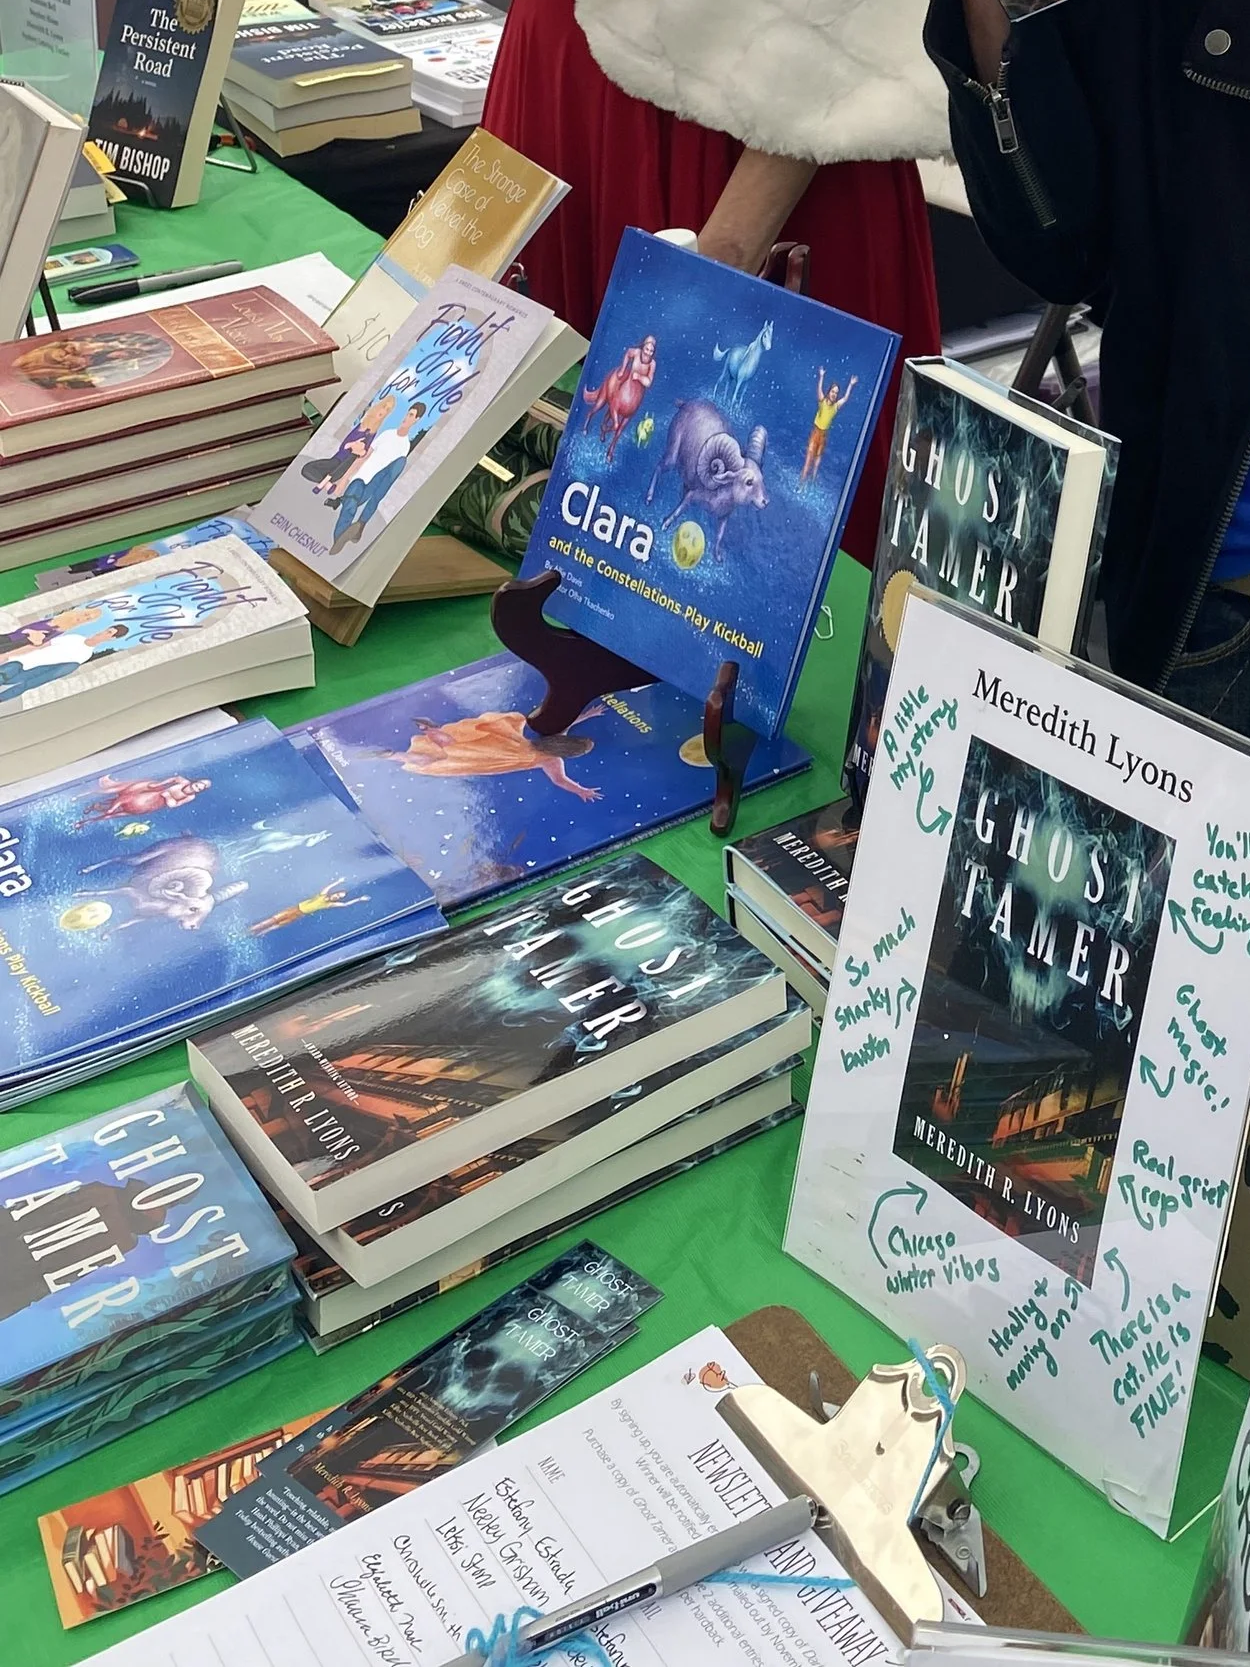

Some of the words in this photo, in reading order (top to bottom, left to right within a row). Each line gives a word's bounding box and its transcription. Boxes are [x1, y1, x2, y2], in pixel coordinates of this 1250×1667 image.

[120, 24, 196, 60] Persistent
[150, 8, 178, 31] The
[235, 26, 282, 39] BISH
[283, 22, 320, 32] TIM
[134, 51, 173, 78] Road
[95, 139, 119, 165] TIM
[120, 146, 170, 181] BISHOP
[446, 168, 476, 203] Case
[475, 196, 493, 211] of
[463, 143, 485, 174] The
[484, 159, 526, 204] Strange
[408, 212, 434, 249] Dog
[430, 189, 465, 228] Velvet
[461, 217, 483, 245] the
[416, 303, 515, 374] Fight
[379, 369, 418, 400] for
[408, 359, 480, 417] Me
[903, 422, 1027, 540] GHOST
[270, 513, 291, 533] ERIN
[288, 524, 328, 557] CHESNUT
[561, 482, 654, 563] Clara
[891, 494, 1018, 624] TAMER
[86, 595, 138, 613] for
[114, 604, 203, 644] Me
[138, 561, 268, 618] Fight
[549, 535, 572, 555] and
[574, 547, 595, 568] the
[597, 560, 681, 615] Constellations
[684, 605, 710, 632] Play
[712, 620, 764, 659] Kickball
[601, 693, 653, 736] tellations
[883, 730, 900, 755] A
[895, 686, 930, 731] little
[890, 698, 958, 790] mystery
[971, 668, 1098, 757] Meredith
[1105, 733, 1194, 804] Lyons
[773, 832, 848, 891] MEREDITH
[975, 790, 1151, 926] GHOST
[561, 880, 716, 1000] GHOST
[845, 956, 871, 987] So
[873, 907, 917, 958] much
[960, 857, 1131, 1008] TAMER
[5, 953, 28, 976] Play
[20, 974, 61, 1017] Kickball
[483, 907, 648, 1040] TAMER
[1176, 984, 1228, 1057] Ghost
[231, 1023, 306, 1094] MEREDITH
[289, 1091, 316, 1113] R.
[304, 1108, 361, 1162] LYONS
[93, 1109, 250, 1279] GHOST
[912, 1115, 996, 1189] MEREDITH
[1000, 1176, 1015, 1204] R.
[1024, 1195, 1081, 1245] LYONS
[1133, 1139, 1174, 1181] Real
[1179, 1174, 1229, 1212] grief
[0, 1142, 140, 1329] TAMER
[1141, 1185, 1179, 1228] rep
[888, 1225, 956, 1259] Chicago
[561, 1275, 610, 1314] TAMER
[583, 1261, 634, 1297] GHOST
[886, 1265, 935, 1295] winter
[943, 1256, 1000, 1285] vibes
[505, 1324, 557, 1362] TAMER
[527, 1307, 579, 1343] GHOST
[989, 1296, 1050, 1358] Healing
[1006, 1338, 1060, 1392] moving
[1051, 1309, 1072, 1340] on
[1089, 1310, 1152, 1365] There
[1147, 1294, 1170, 1323] is
[1142, 1340, 1170, 1377] He
[1168, 1321, 1191, 1348] is
[1130, 1359, 1186, 1439] FINE!
[312, 1462, 344, 1490] Meredith
[350, 1492, 374, 1513] Lyons
[538, 1456, 565, 1484] NAME
[582, 1428, 611, 1465] Purchase
[607, 1461, 615, 1470] a
[614, 1468, 629, 1489] copy
[625, 1485, 637, 1498] of
[633, 1496, 656, 1522] Ghost
[651, 1519, 672, 1545] Tamer
[611, 1398, 622, 1411] By
[620, 1409, 643, 1440] signing
[650, 1447, 664, 1466] you
[660, 1464, 674, 1478] are
[670, 1475, 713, 1527] automatically
[687, 1439, 774, 1518] NEWSLETT
[495, 1477, 535, 1537] Estefany
[635, 1457, 658, 1487] Winner
[655, 1484, 669, 1500] will
[666, 1497, 678, 1512] be
[676, 1507, 701, 1539] notified
[764, 1539, 817, 1578] AND
[680, 1591, 694, 1608] per
[691, 1603, 725, 1648] hardback
[703, 1591, 713, 1600] 2
[708, 1598, 741, 1640] additional
[749, 1607, 764, 1625] out
[762, 1622, 772, 1636] by
[756, 1588, 783, 1620] signed
[778, 1616, 799, 1640] copy
[795, 1636, 807, 1648] of
